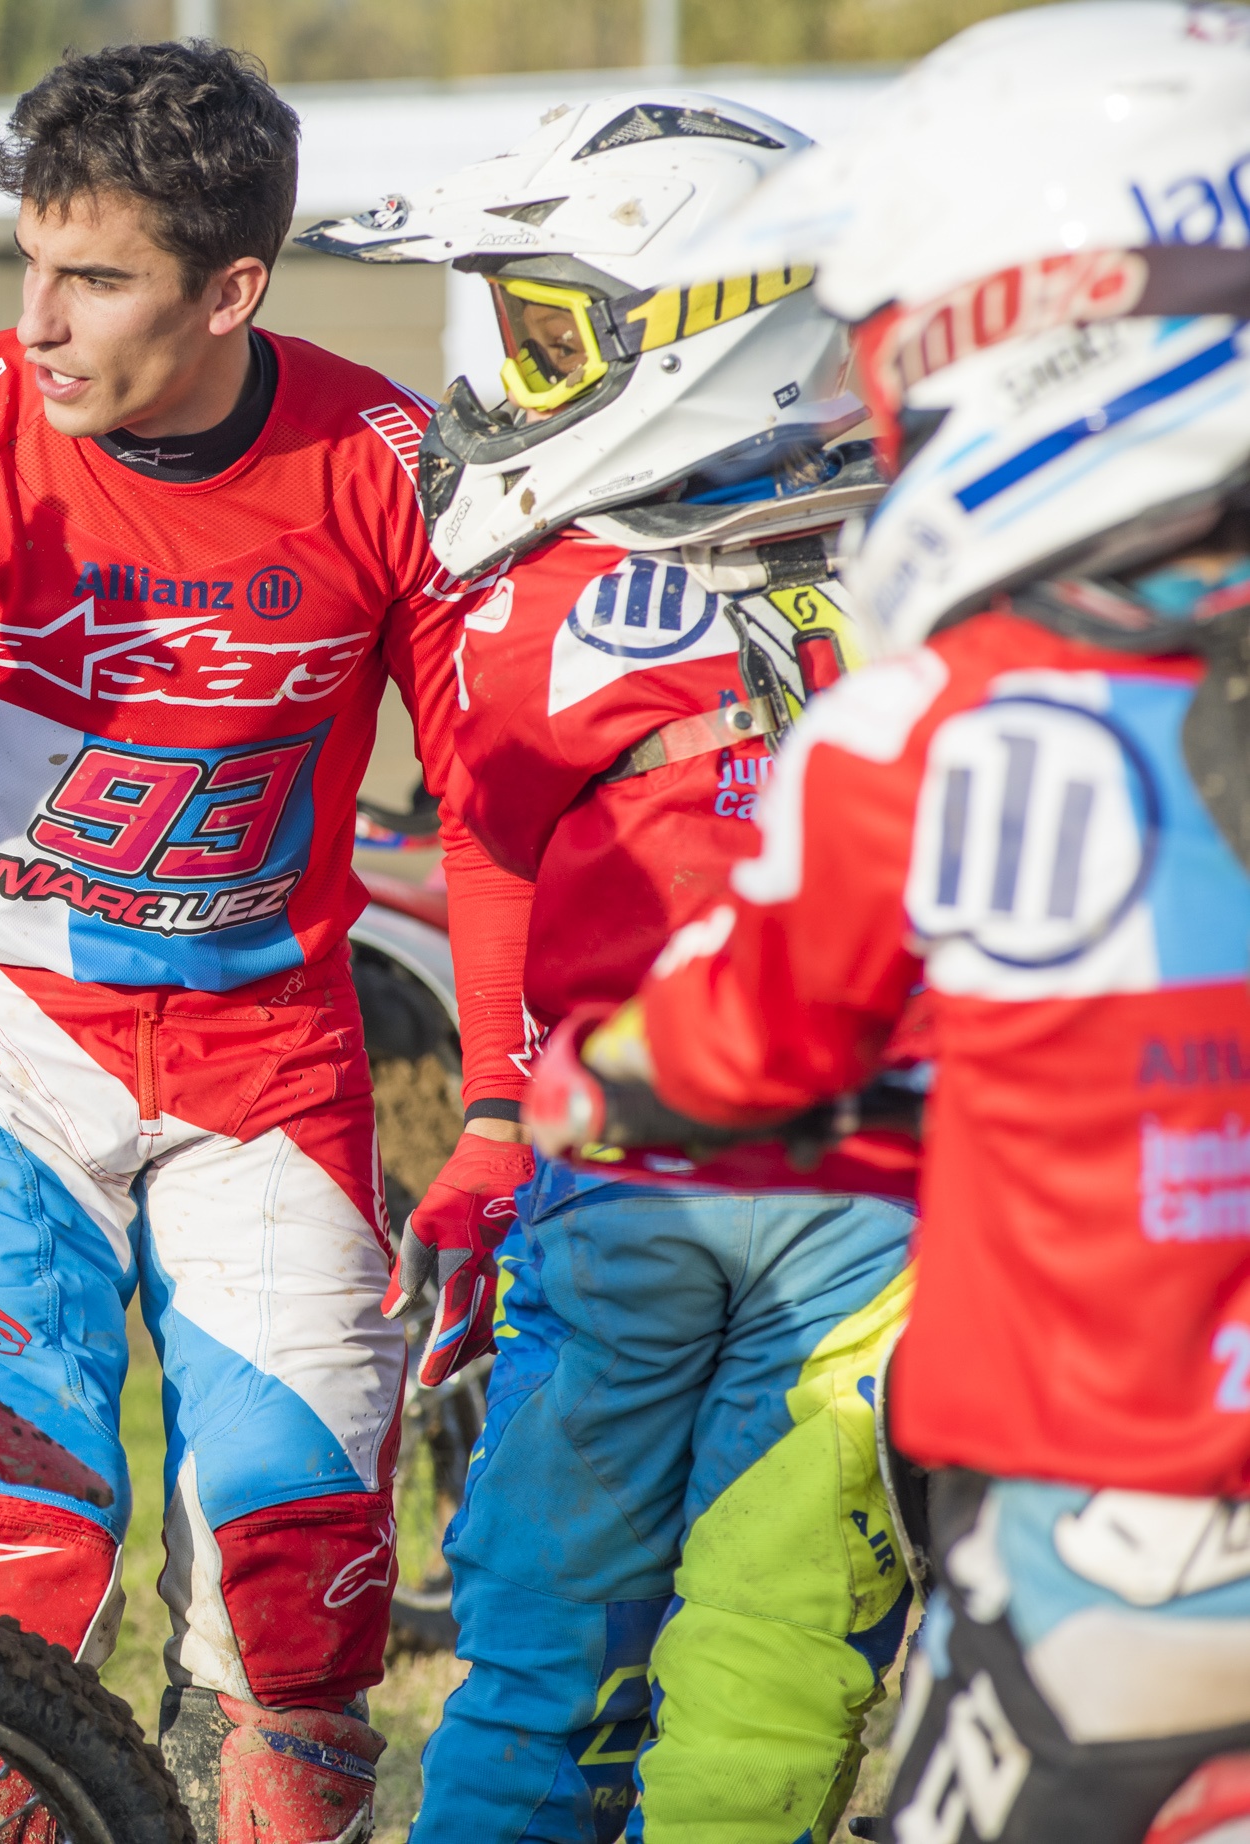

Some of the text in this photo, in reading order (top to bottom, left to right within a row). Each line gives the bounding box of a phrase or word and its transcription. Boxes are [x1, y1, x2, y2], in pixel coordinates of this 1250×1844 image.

[72, 561, 234, 609] Allianz
[27, 740, 313, 884] 93
[850, 1509, 897, 1577] AIR
